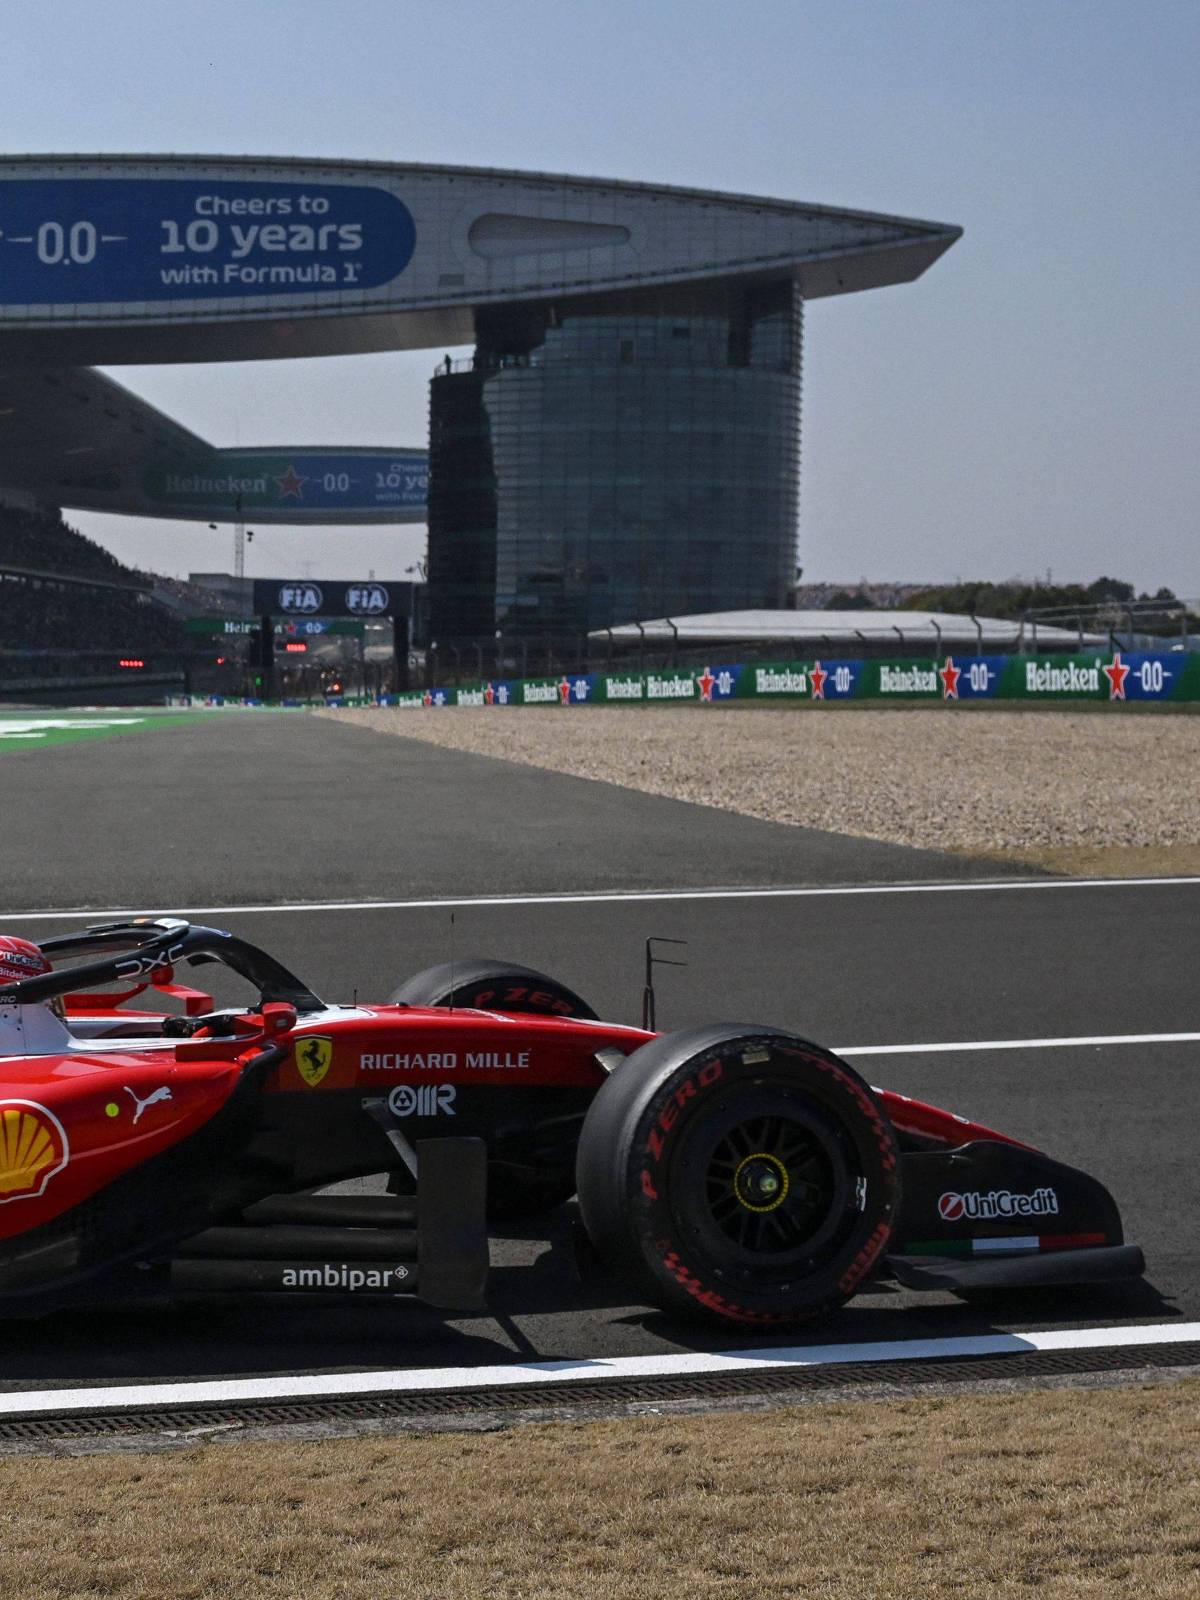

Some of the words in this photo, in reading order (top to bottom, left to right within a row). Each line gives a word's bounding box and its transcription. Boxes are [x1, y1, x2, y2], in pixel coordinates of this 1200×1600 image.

[195, 196, 292, 215] Cheers
[298, 195, 329, 214] to
[161, 219, 219, 253] 10
[231, 224, 363, 258] years
[161, 265, 218, 284] with
[224, 264, 336, 283] Formula
[375, 473, 400, 488] 10
[756, 668, 807, 692] Heineken
[880, 665, 938, 692] Heineken
[1026, 660, 1100, 692] Heineken
[360, 1053, 457, 1070] RICHARD
[466, 1052, 530, 1068] MILLE
[965, 1188, 1058, 1219] UniCredit
[282, 1264, 394, 1291] ambipar
